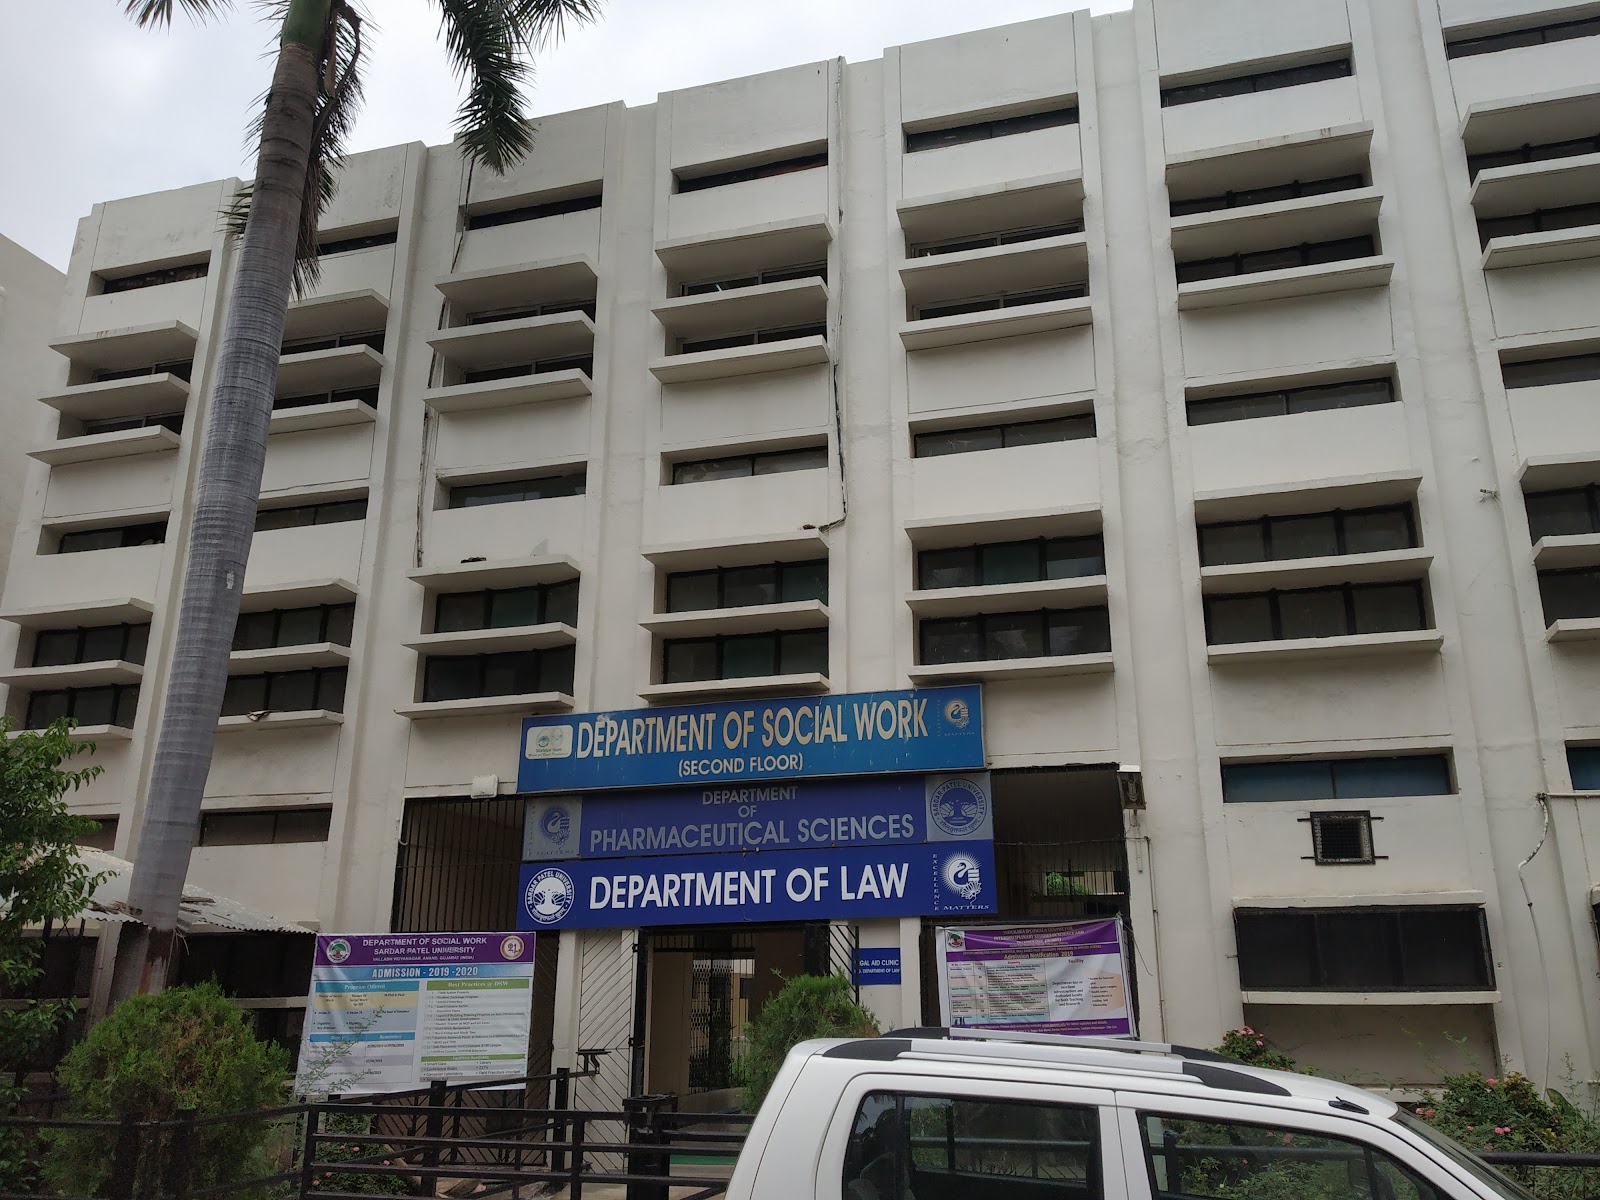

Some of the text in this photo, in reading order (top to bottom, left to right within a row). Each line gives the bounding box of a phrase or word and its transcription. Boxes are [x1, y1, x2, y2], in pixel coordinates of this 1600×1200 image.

[577, 712, 716, 759] DEPARTMENT
[723, 710, 754, 750] OF
[762, 704, 847, 747] SOCIAL
[853, 698, 928, 740] WORK
[678, 752, 803, 778] (SECOND FLOOR)
[702, 786, 798, 805] DEPARTMENT
[942, 782, 960, 791] PATEL
[963, 782, 984, 816] UNIVERSITY
[738, 805, 757, 818] OF
[590, 820, 790, 852] PHARMACEUTICAL
[797, 813, 914, 842] SCIENCES
[537, 871, 554, 882] PATEL
[589, 863, 909, 909] DEPARTMENT OF LAW
[932, 853, 940, 911] EXCELLENCE
[362, 938, 417, 946] DEPARTMENT
[431, 937, 460, 945] SOCIAL
[432, 946, 475, 954] UNIVERSITY
[372, 967, 420, 978] ADMISSION
[429, 967, 449, 977] 2019
